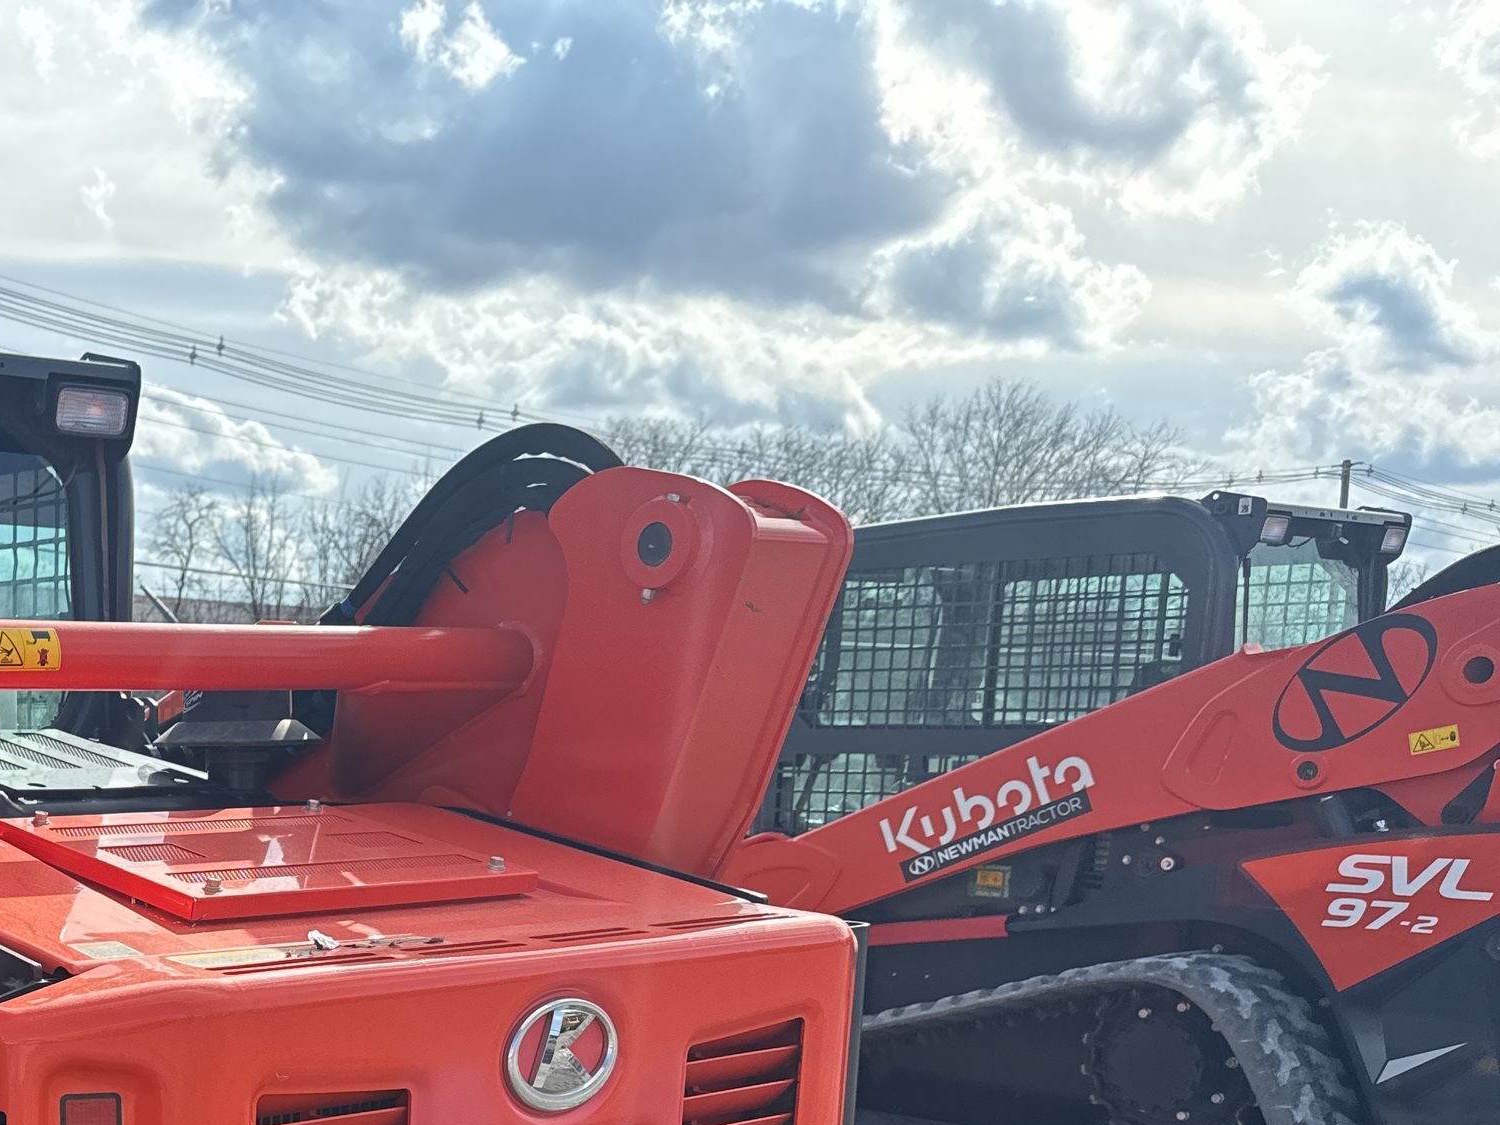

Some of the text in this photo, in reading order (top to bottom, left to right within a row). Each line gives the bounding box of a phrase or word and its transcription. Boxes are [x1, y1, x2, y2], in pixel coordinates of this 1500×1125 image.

[879, 756, 1095, 854] Kubota
[1325, 853, 1494, 901] SVL
[1321, 897, 1439, 934] 97-2
